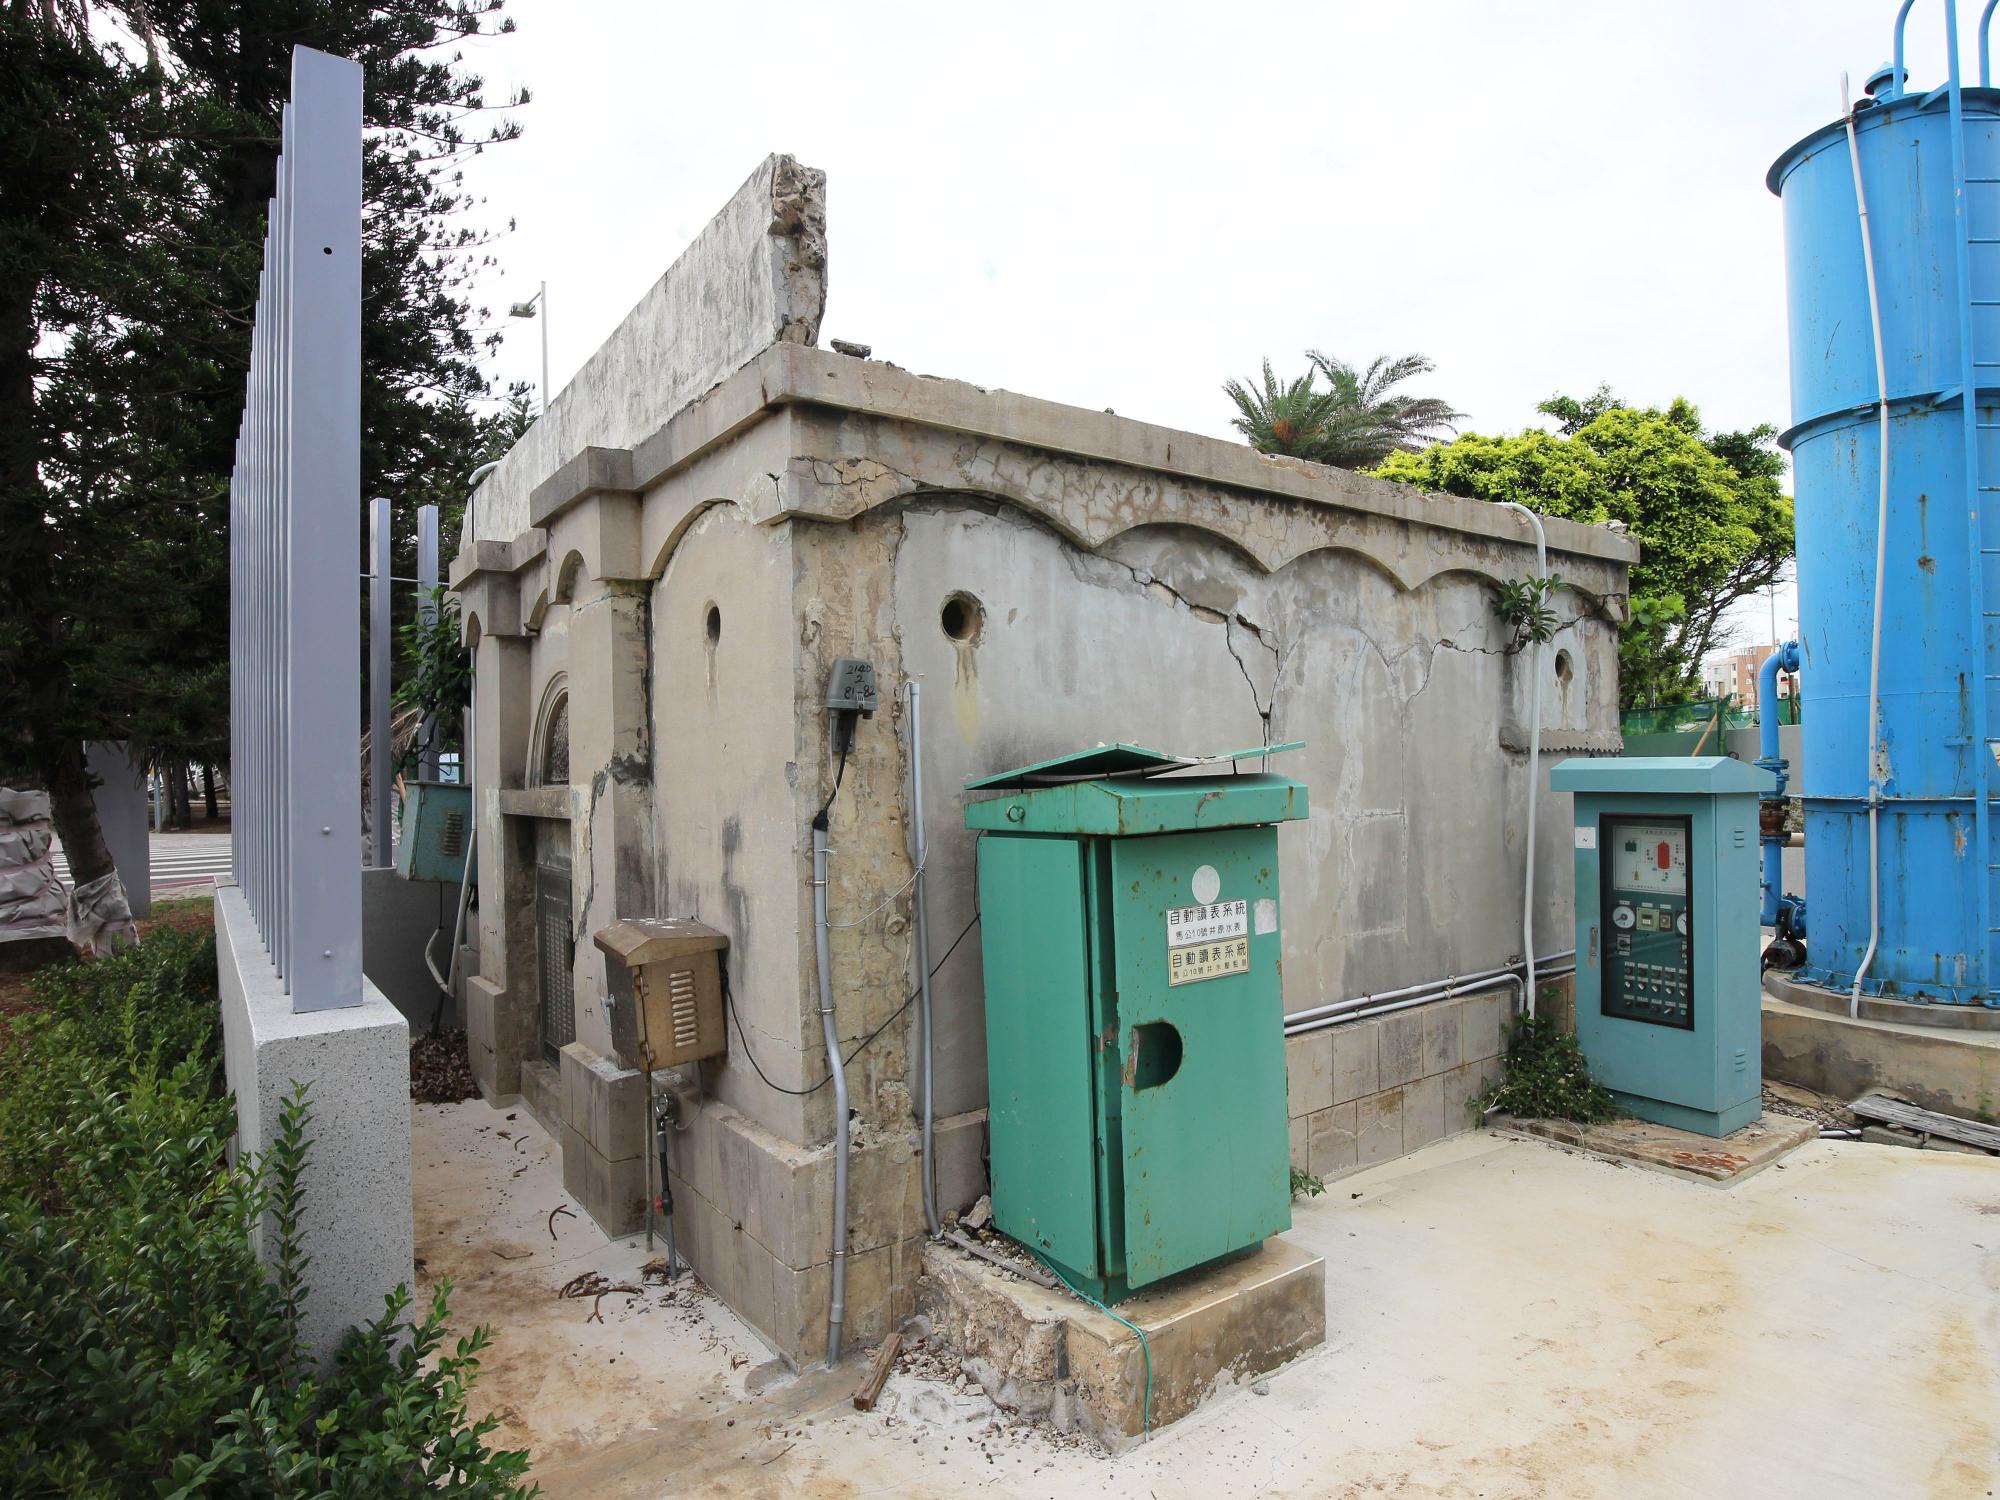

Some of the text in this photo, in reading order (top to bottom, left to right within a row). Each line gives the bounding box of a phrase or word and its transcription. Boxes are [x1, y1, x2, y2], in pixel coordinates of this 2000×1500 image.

[854, 675, 864, 684] 2
[1170, 902, 1246, 925] 自動讀表系統
[1172, 942, 1247, 968] 自動讀表系統
